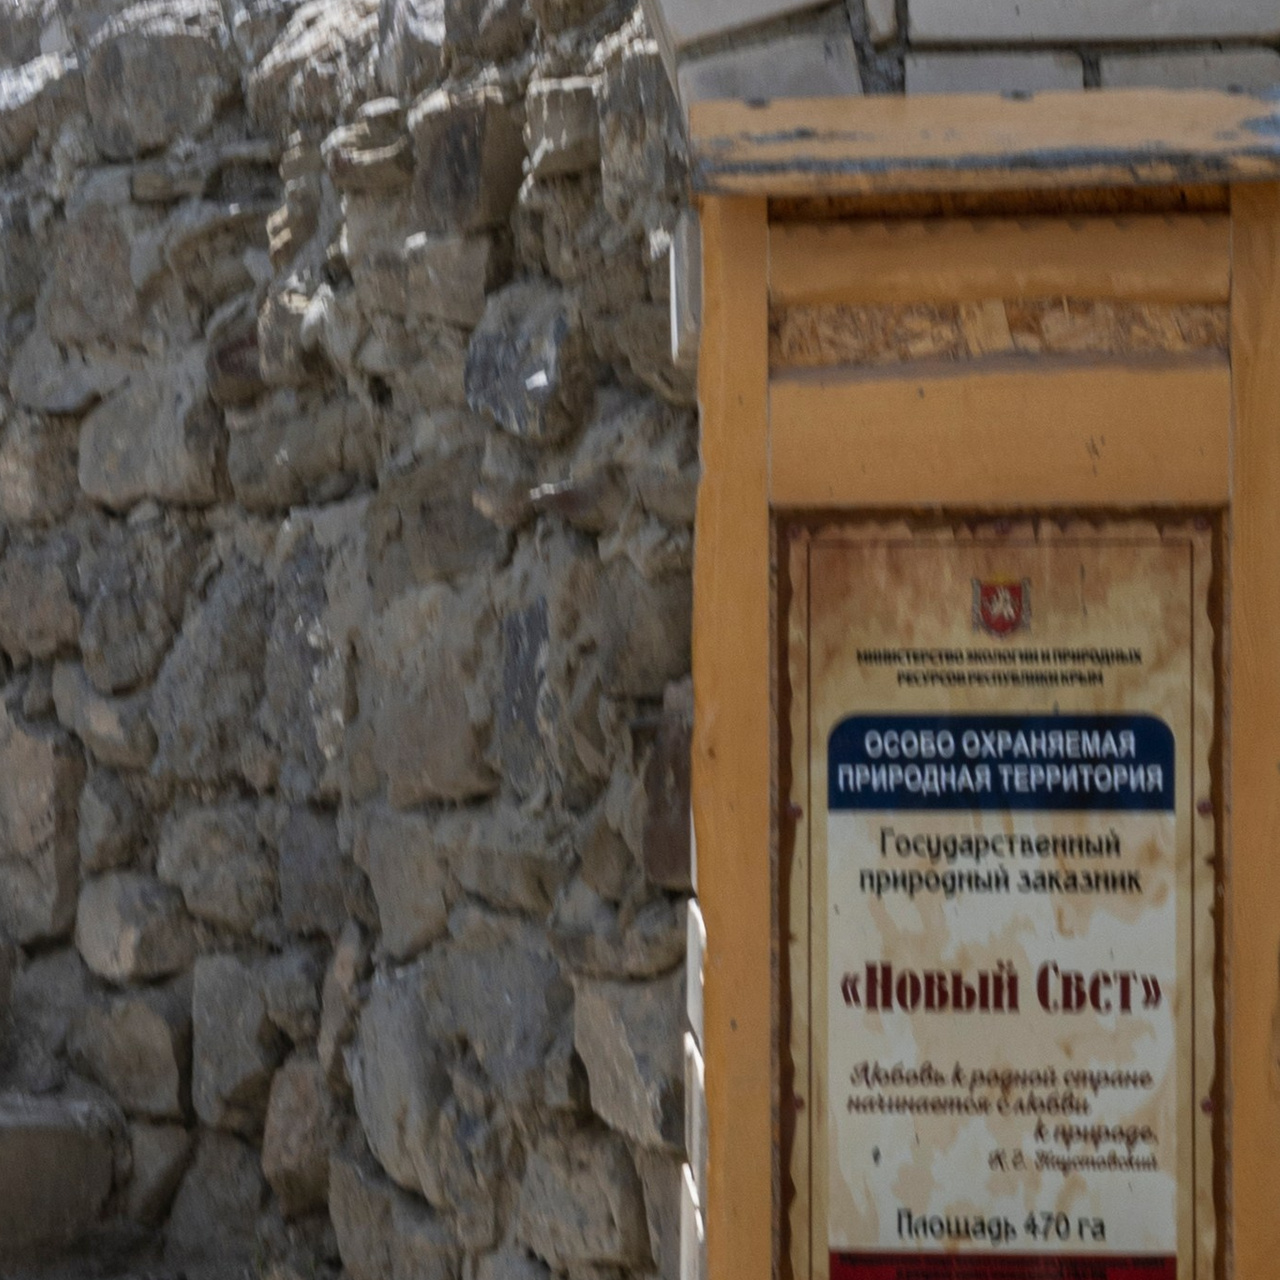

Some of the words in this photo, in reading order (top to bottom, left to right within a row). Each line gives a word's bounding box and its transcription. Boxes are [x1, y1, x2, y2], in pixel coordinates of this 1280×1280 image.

[864, 730, 955, 759] ОСОБО
[962, 730, 1135, 758] ОХРАНЯЕМАЯ
[838, 764, 990, 795] ПРИРОДНАЯ
[998, 764, 1163, 793] ТЕРРИТОРИЯ
[880, 826, 1120, 862] Государственный
[860, 864, 1009, 898] природный
[1018, 870, 1142, 894] заказник
[841, 959, 1019, 1015] «Новый
[1036, 959, 1162, 1016] Свет»
[897, 1207, 1017, 1246] Площадь
[1024, 1211, 1070, 1241] 470
[1078, 1216, 1106, 1242] га
